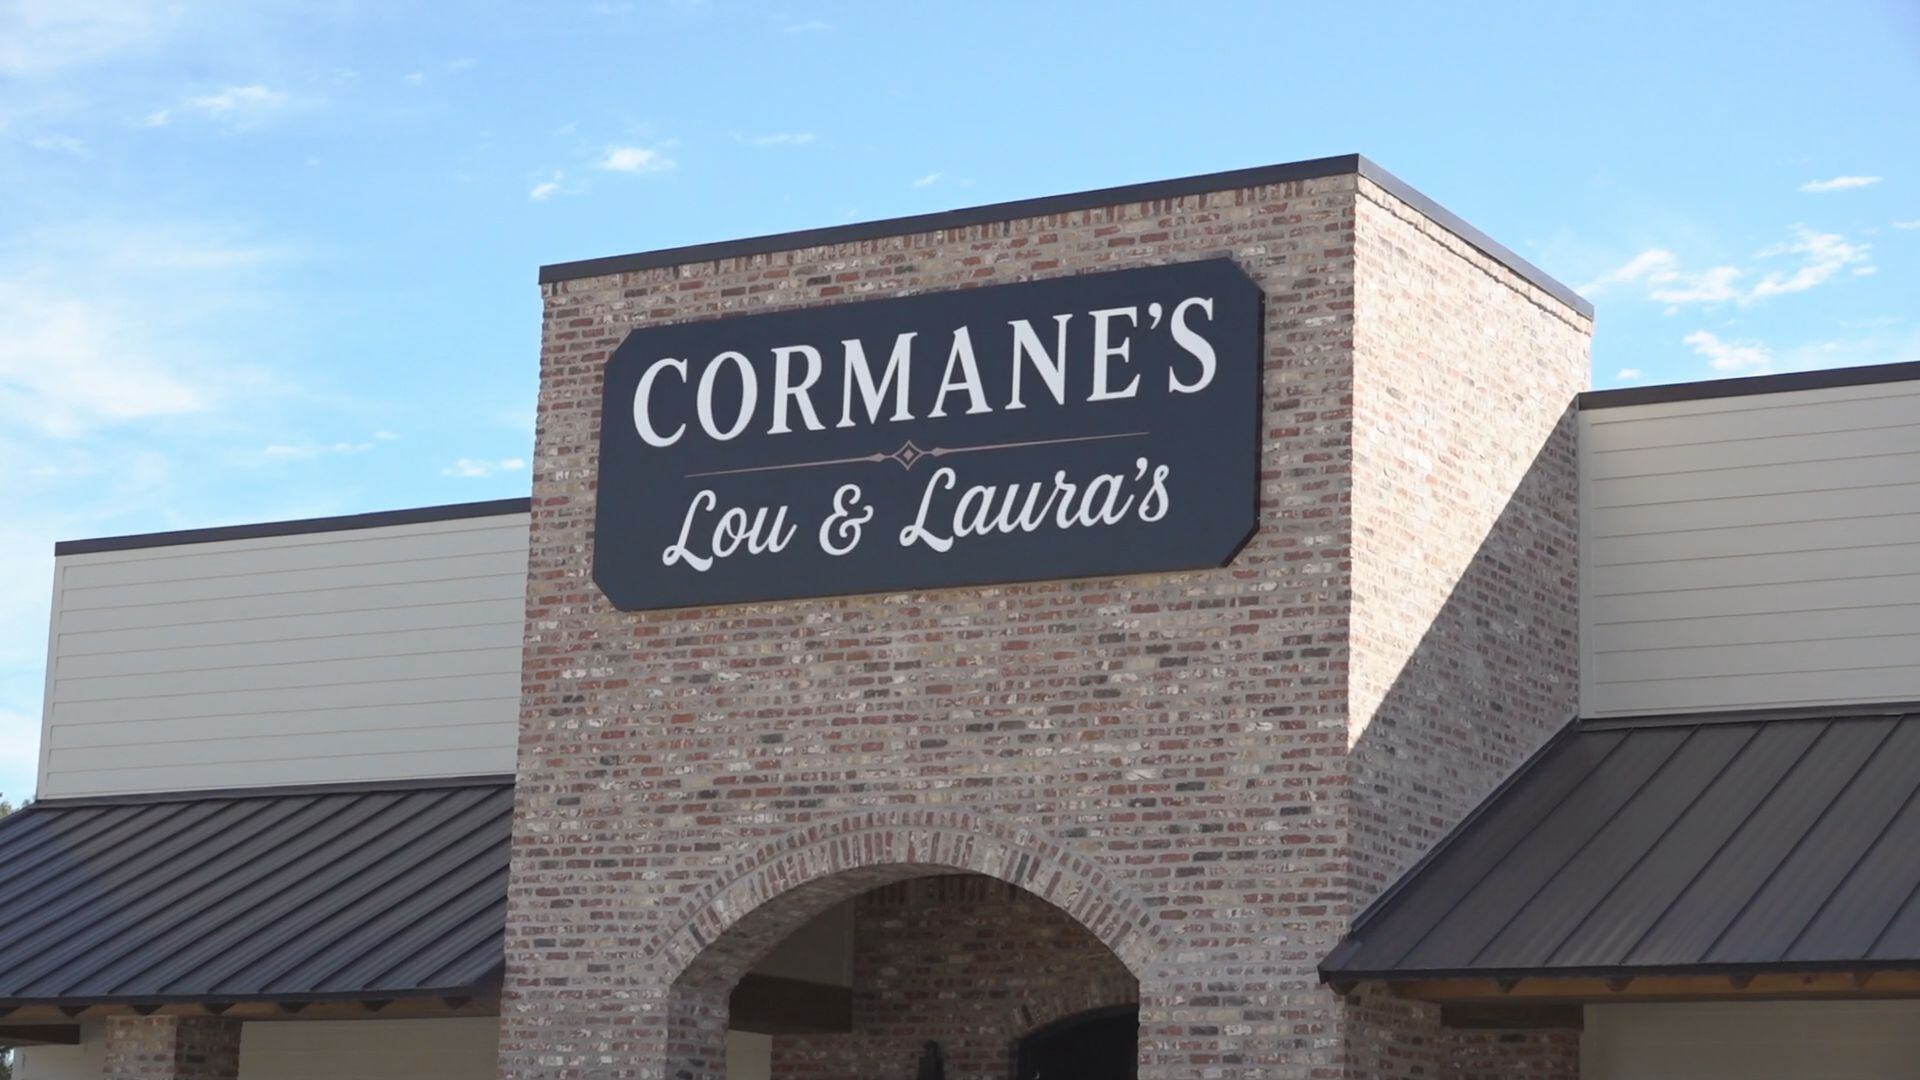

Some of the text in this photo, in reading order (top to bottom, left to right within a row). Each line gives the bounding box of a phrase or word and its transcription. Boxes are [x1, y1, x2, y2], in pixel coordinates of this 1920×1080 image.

[633, 297, 1217, 448] CORMANE’S
[662, 457, 1170, 572] Lou & Laura’s
